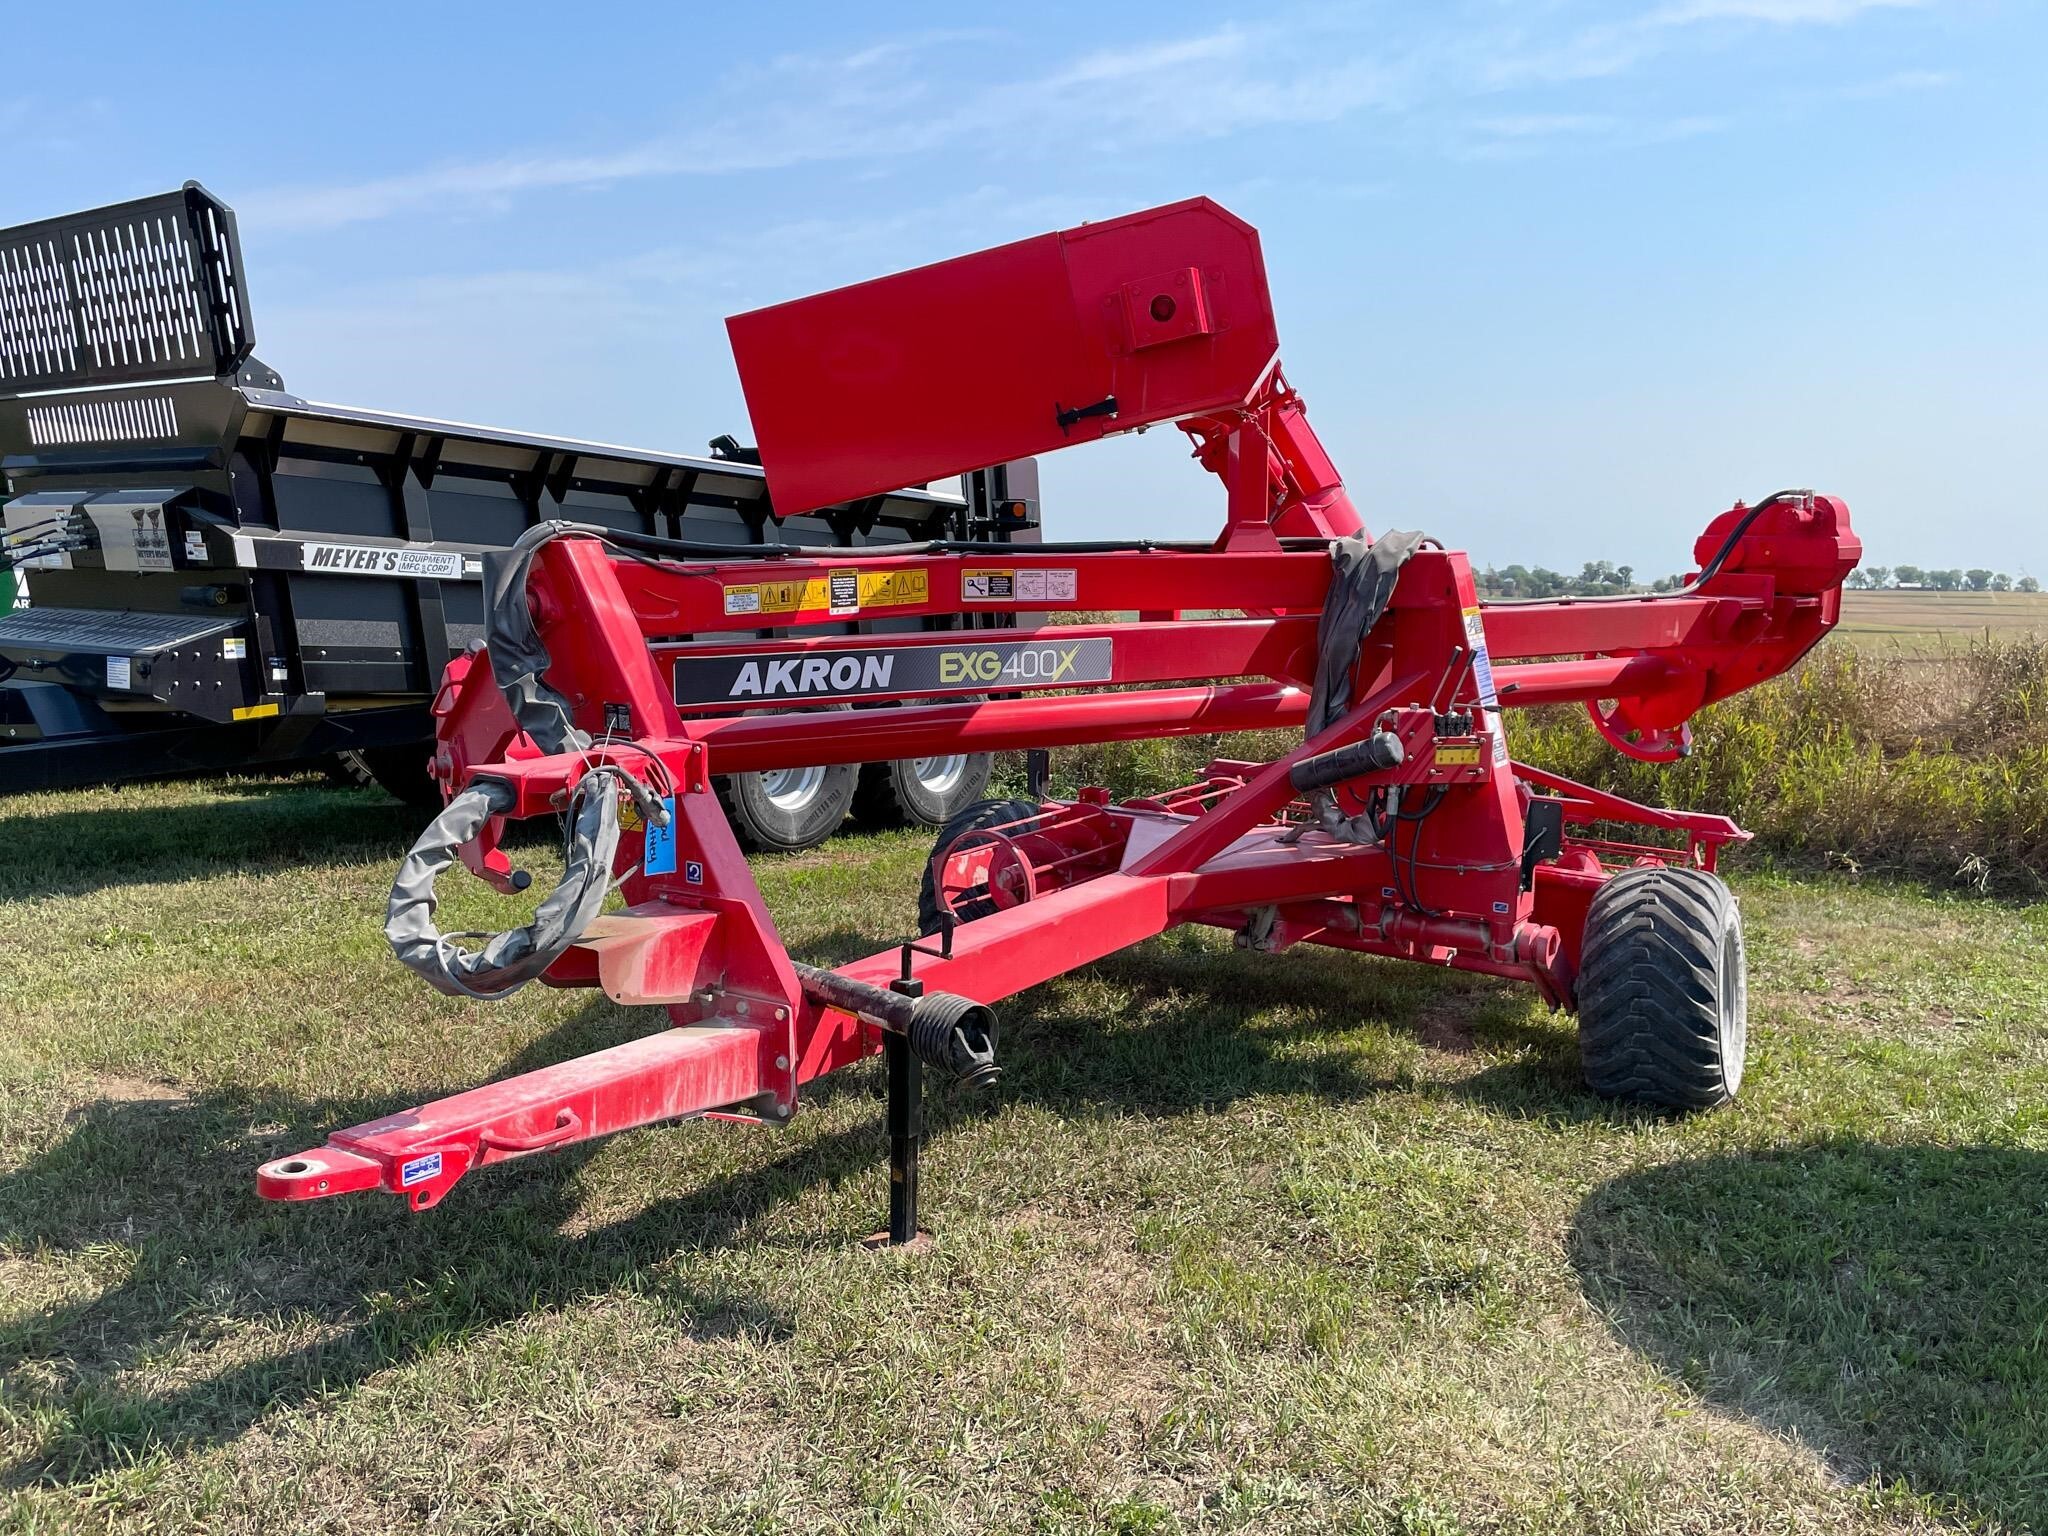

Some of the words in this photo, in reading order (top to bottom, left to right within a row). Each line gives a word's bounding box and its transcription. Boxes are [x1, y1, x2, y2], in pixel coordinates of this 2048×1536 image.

[311, 547, 398, 571] MEYER'S
[403, 554, 453, 565] EQUIPMENT
[12, 598, 31, 609] AR
[729, 655, 894, 696] AKRON
[939, 644, 1081, 683] EXG400X
